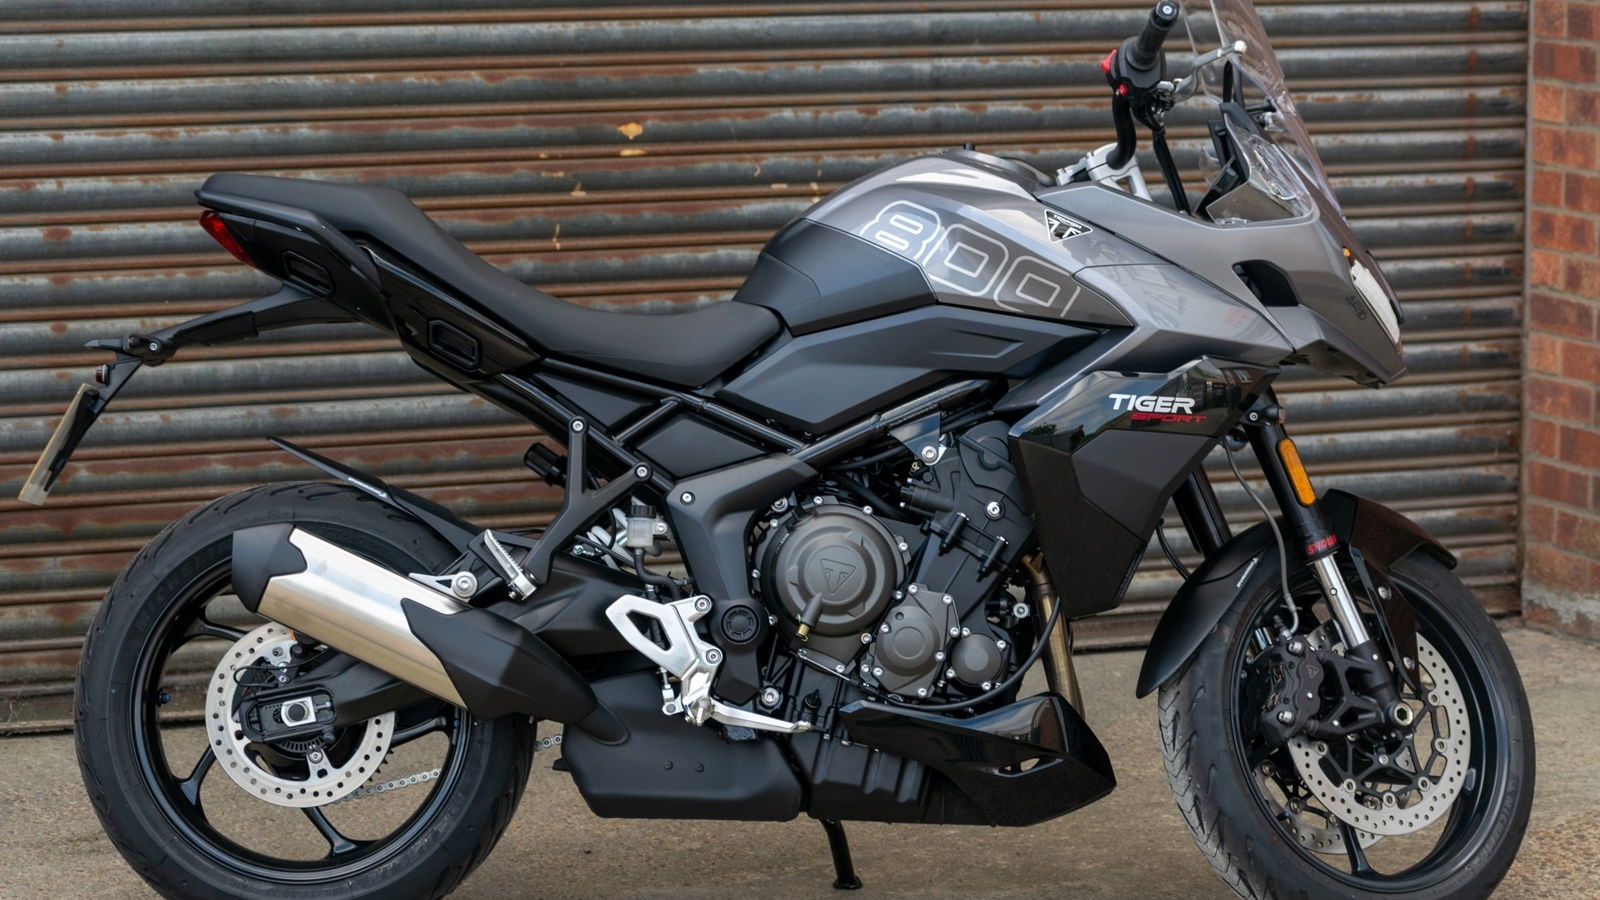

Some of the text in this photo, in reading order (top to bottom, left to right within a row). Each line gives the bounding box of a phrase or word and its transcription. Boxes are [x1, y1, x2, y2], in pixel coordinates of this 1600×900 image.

[859, 200, 1080, 317] 800
[1108, 393, 1195, 414] TIGER
[1131, 412, 1207, 424] SPORT
